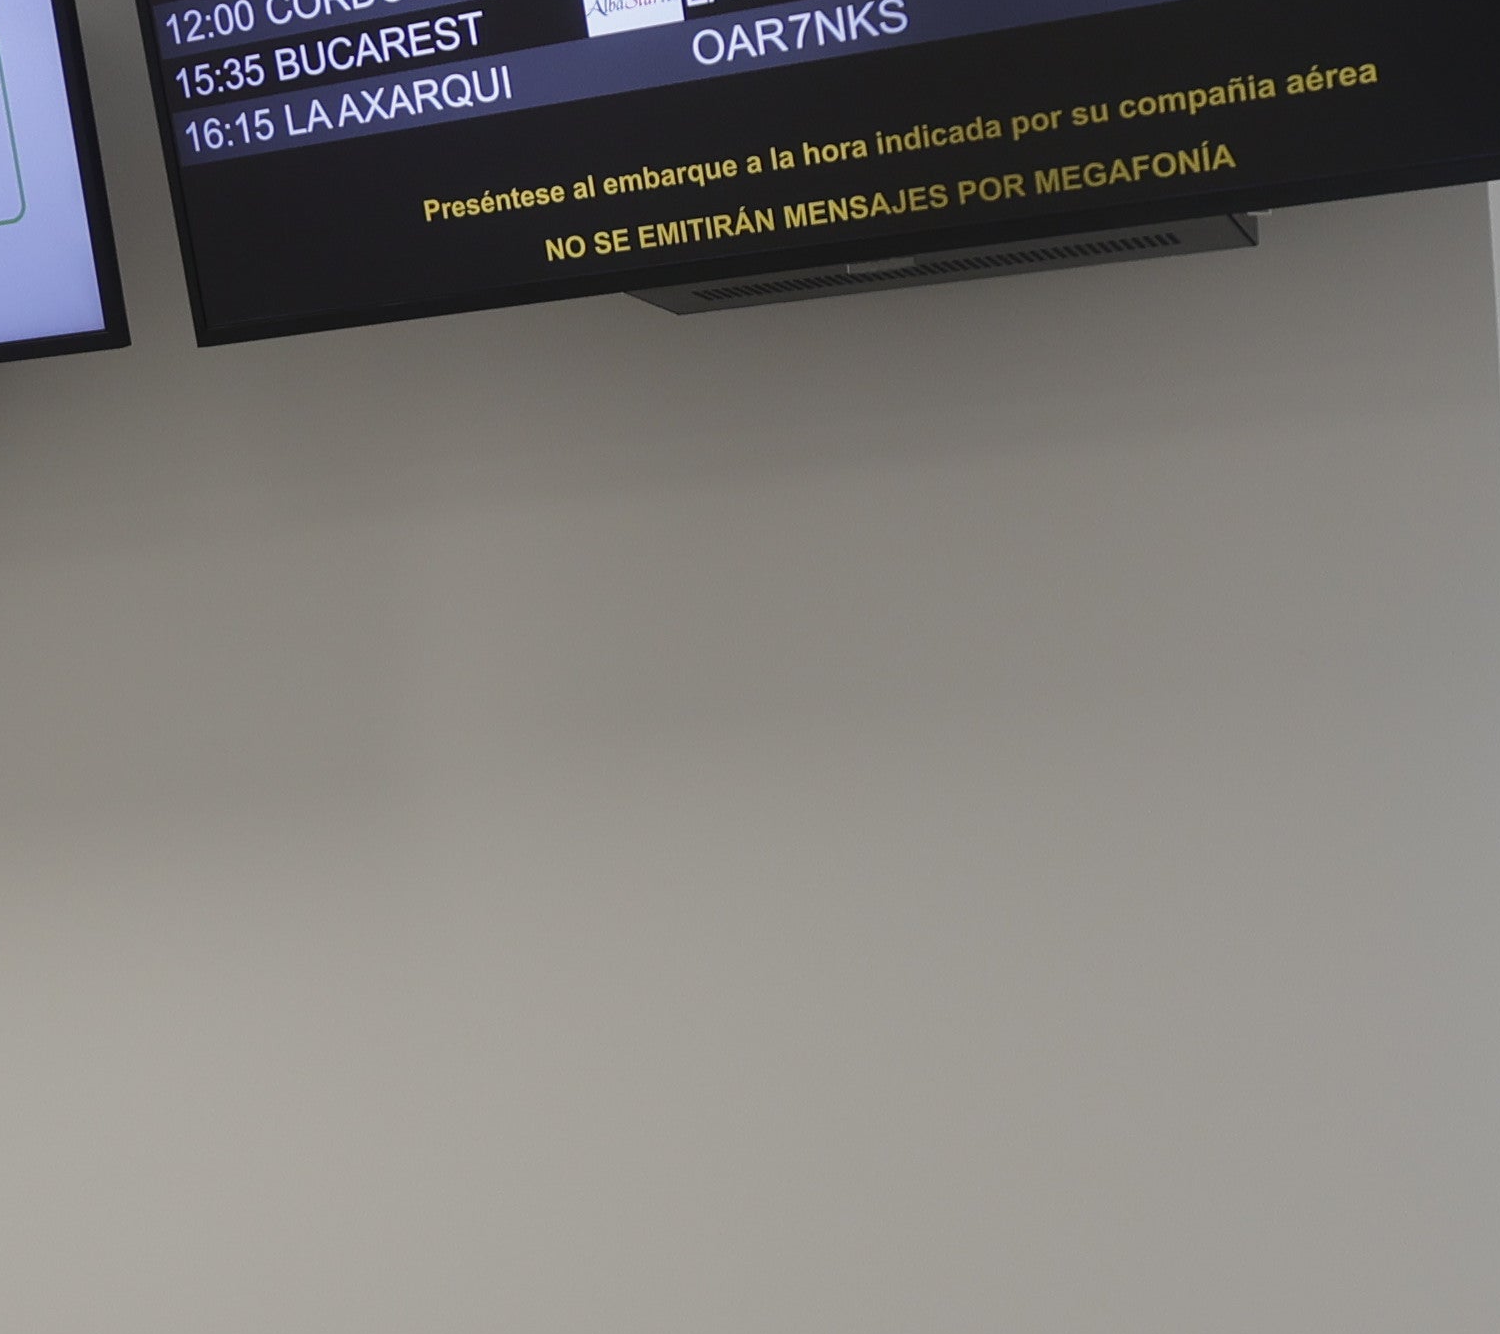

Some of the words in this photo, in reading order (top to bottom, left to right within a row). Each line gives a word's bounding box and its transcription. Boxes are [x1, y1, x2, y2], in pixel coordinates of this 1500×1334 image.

[174, 53, 266, 99] 15:35
[274, 10, 484, 82] BUCAREST
[184, 107, 275, 153] 16:15
[422, 183, 566, 223] Preséntese
[572, 174, 597, 200] al
[602, 159, 739, 196] embarque
[745, 154, 763, 174] a
[769, 146, 796, 172] la
[802, 137, 868, 167] hora
[874, 115, 1003, 155] indicada
[1011, 109, 1063, 141] por
[1070, 104, 1109, 127] su
[1285, 62, 1379, 96] aérea
[544, 234, 587, 263] NO
[593, 227, 632, 256] SE
[638, 205, 776, 250] EMITIRÁN
[783, 183, 949, 230] MENSAJES
[956, 172, 1027, 206] POR
[1033, 140, 1238, 196] MEGAFONÍA
